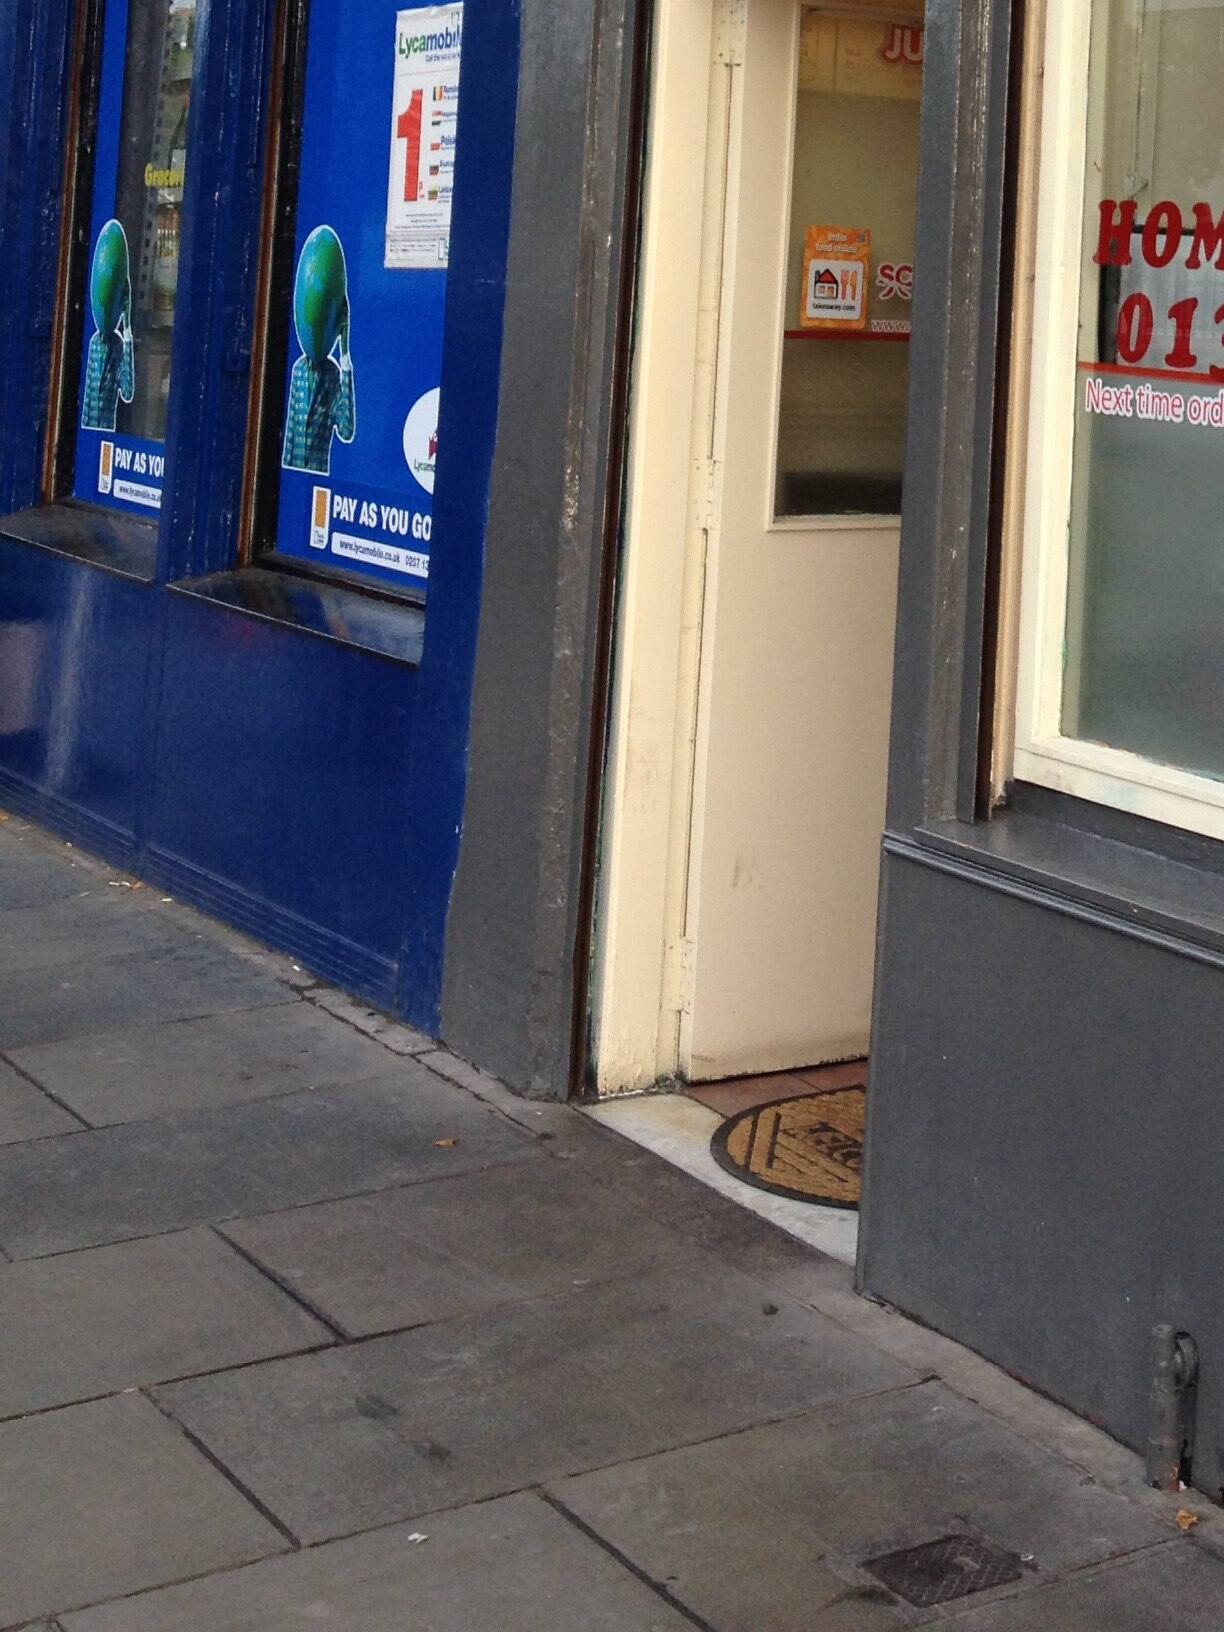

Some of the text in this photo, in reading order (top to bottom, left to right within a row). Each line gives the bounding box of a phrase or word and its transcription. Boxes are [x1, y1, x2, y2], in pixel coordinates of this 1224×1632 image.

[396, 88, 423, 201] 1
[1085, 378, 1133, 415] Next
[1135, 382, 1184, 422] time
[115, 447, 132, 471] PAY
[133, 452, 147, 474] AS
[333, 495, 432, 541] PAY AS YOU GO
